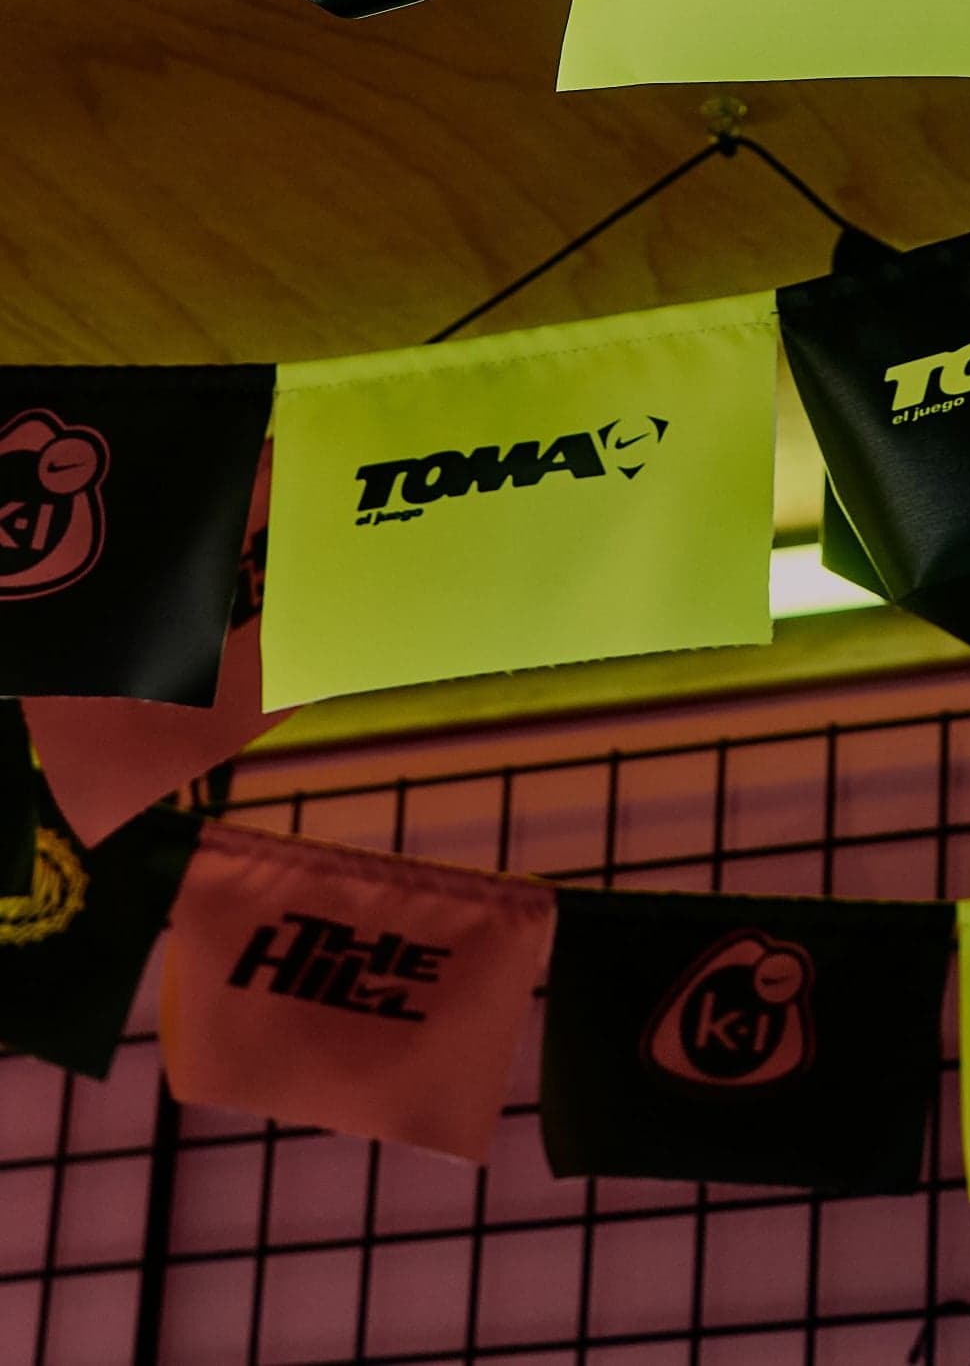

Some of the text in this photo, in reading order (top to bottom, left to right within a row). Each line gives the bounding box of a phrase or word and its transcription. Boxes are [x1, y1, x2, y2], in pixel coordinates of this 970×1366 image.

[892, 396, 966, 425] el juego
[355, 431, 606, 512] TOMA
